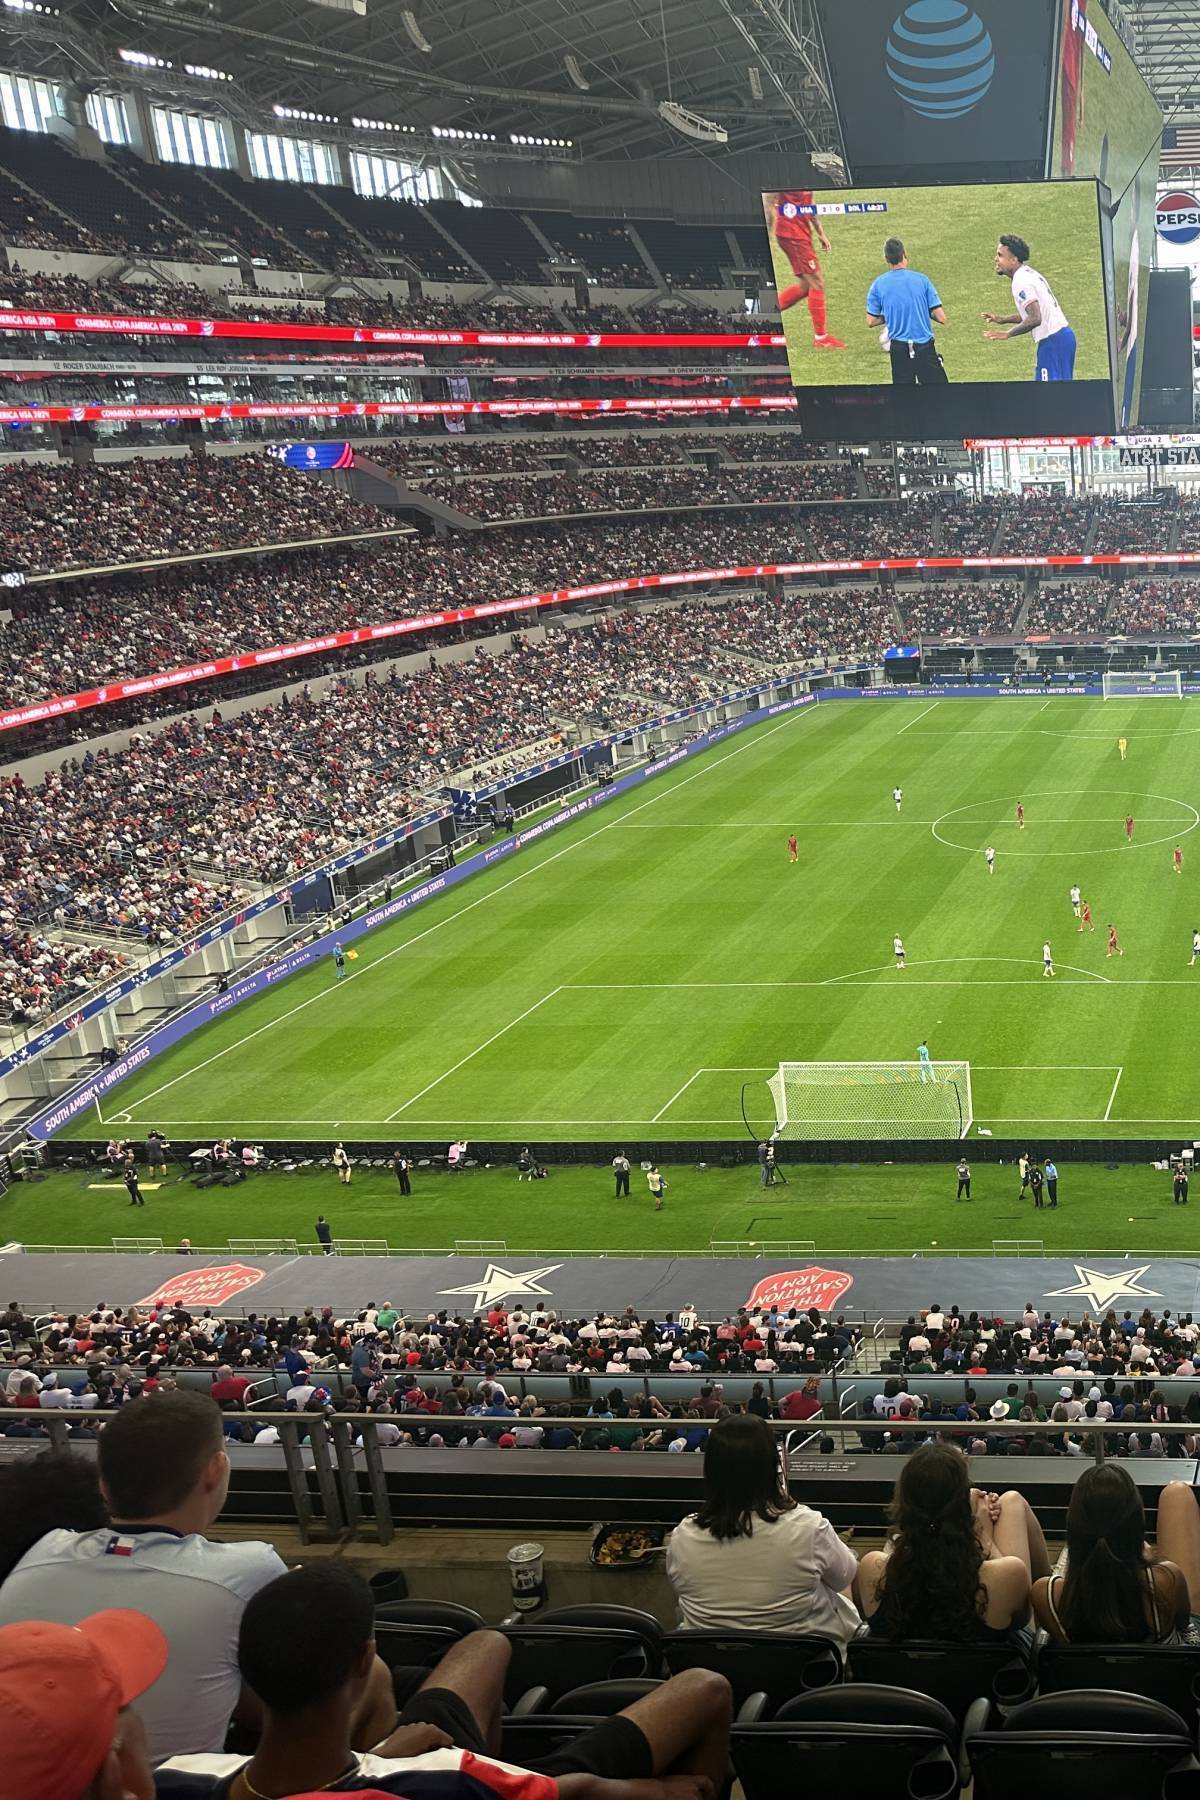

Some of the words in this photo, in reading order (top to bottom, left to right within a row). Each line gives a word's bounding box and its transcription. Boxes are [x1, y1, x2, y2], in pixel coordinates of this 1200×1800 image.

[1041, 368, 1048, 381] 8
[1121, 448, 1165, 466] AT&T
[366, 910, 384, 927] SOUTH
[384, 898, 408, 917] AMERICA
[411, 888, 428, 902] UNITED
[428, 878, 445, 893] STATES
[296, 953, 310, 964] DELTA
[241, 982, 256, 994] DELTA
[45, 1111, 69, 1132] SOUTH
[69, 1085, 100, 1112] AMERICA
[104, 1064, 127, 1086] UNITED
[128, 1046, 150, 1069] STATES
[152, 1275, 258, 1302] SALVATION
[172, 1270, 241, 1289] ARMY
[765, 1272, 824, 1293] ARMY
[752, 1278, 847, 1307] SALVATION
[784, 1294, 823, 1310] THE
[680, 1317, 690, 1327] 10
[356, 1328, 366, 1336] 10
